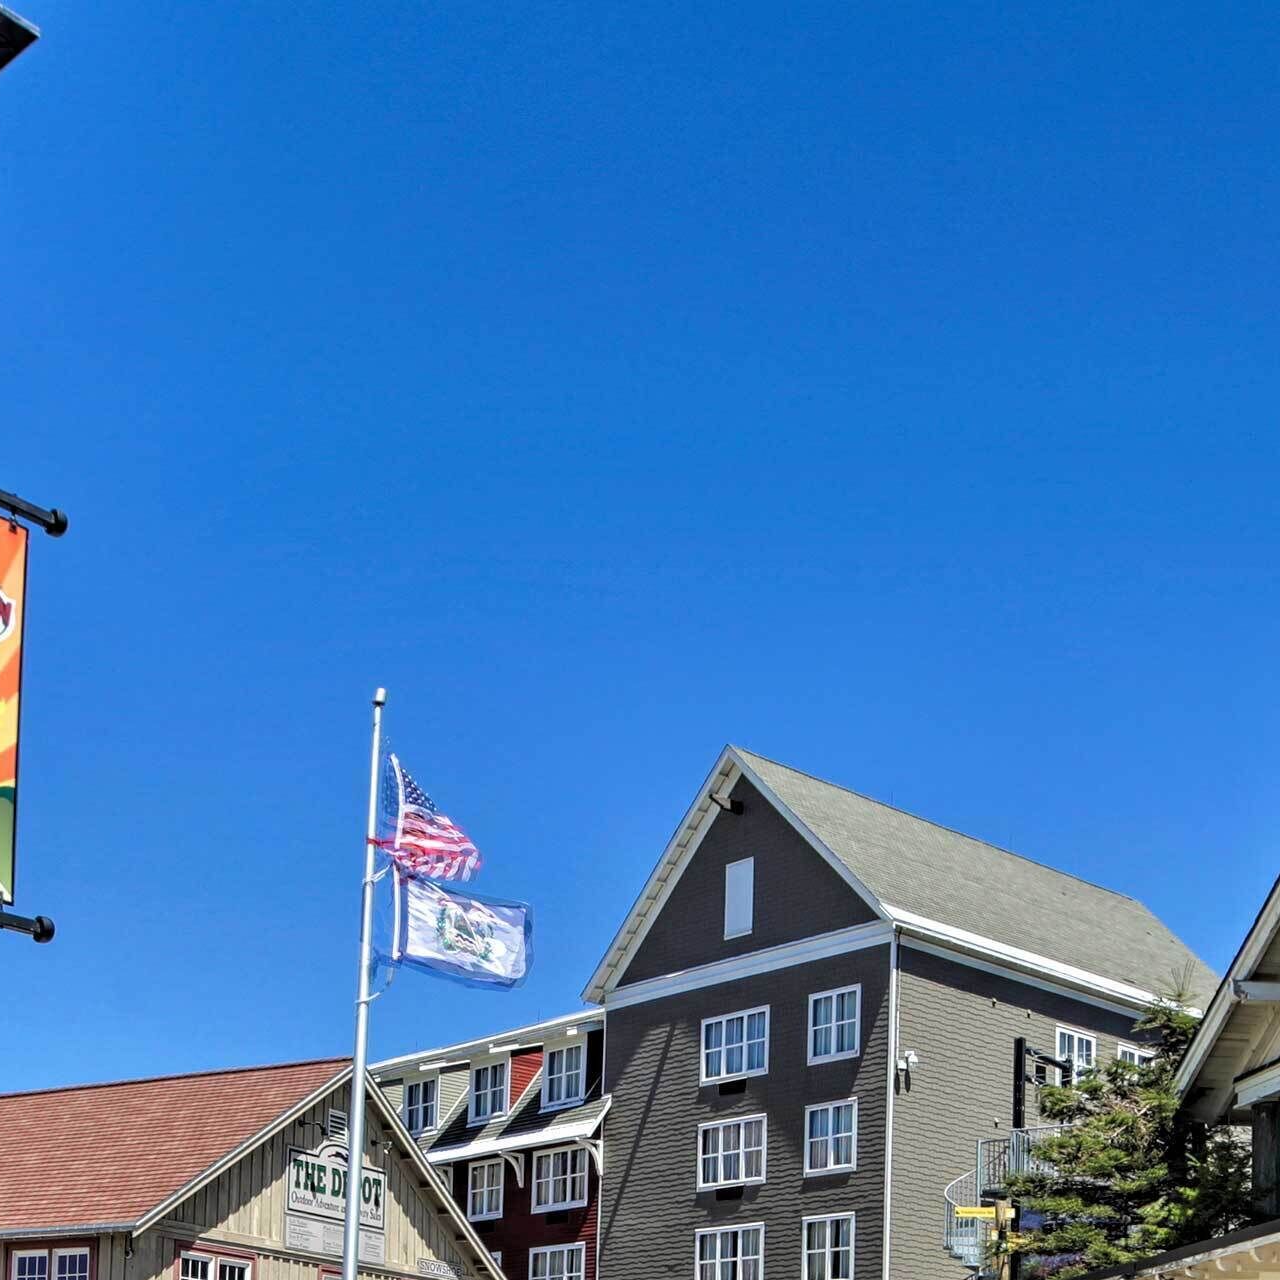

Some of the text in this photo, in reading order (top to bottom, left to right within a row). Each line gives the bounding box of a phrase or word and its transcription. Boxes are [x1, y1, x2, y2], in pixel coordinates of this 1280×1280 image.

[292, 1158, 383, 1208] THE DOT
[420, 1260, 464, 1277] SNOWSHOE
